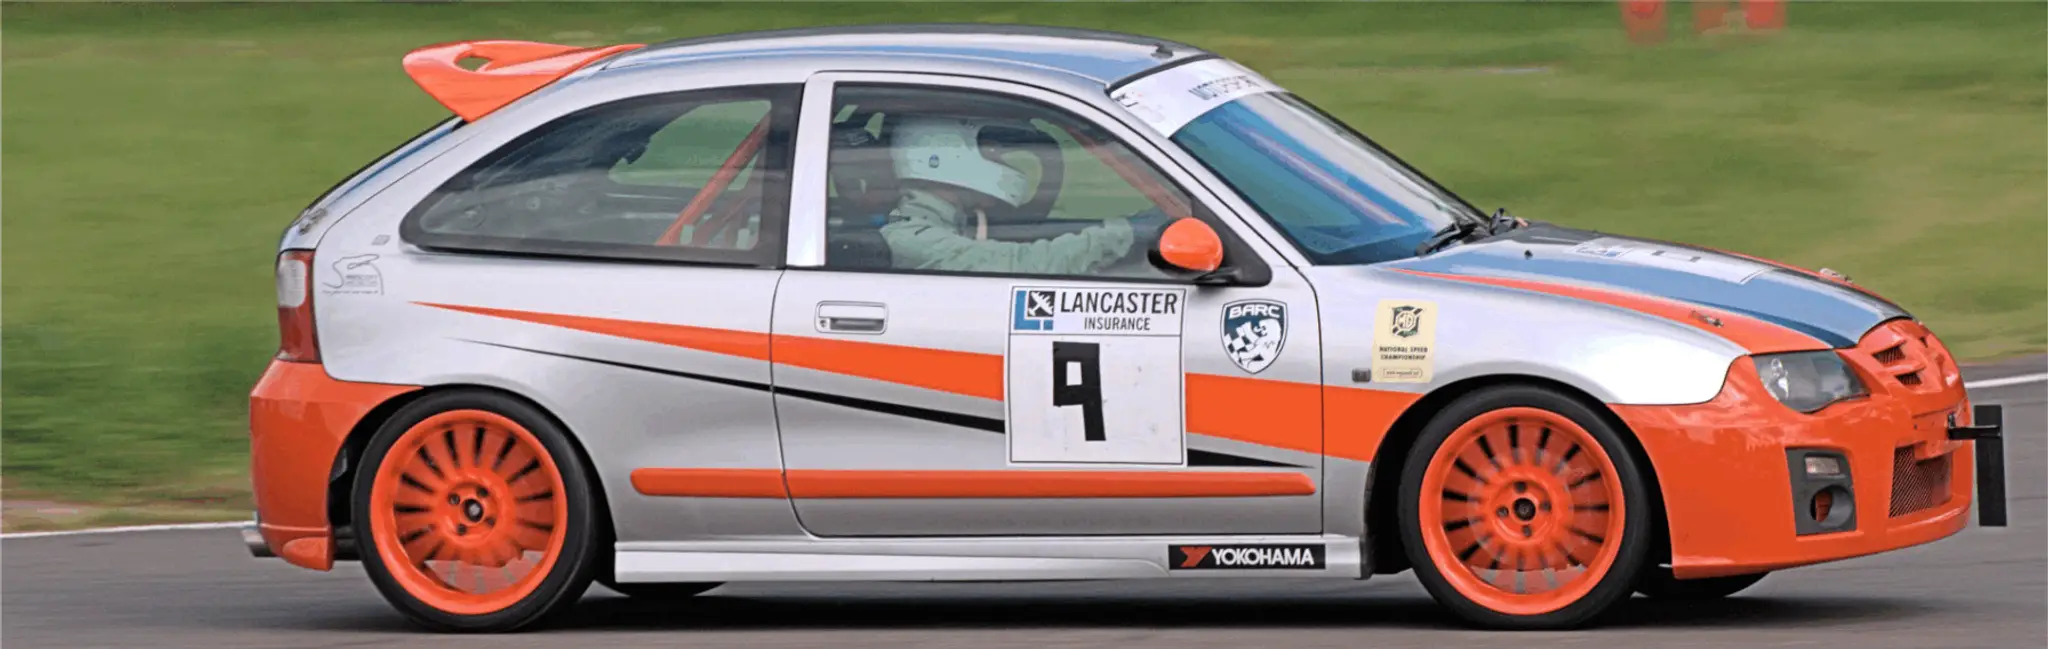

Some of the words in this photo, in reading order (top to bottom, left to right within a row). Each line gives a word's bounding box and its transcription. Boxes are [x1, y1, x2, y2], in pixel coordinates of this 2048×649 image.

[1060, 291, 1178, 315] LANCASTER
[1228, 304, 1280, 319] BARC
[1084, 317, 1151, 330] INSURANCE
[1052, 341, 1107, 441] 9
[1212, 548, 1315, 566] YOKOHAMA
